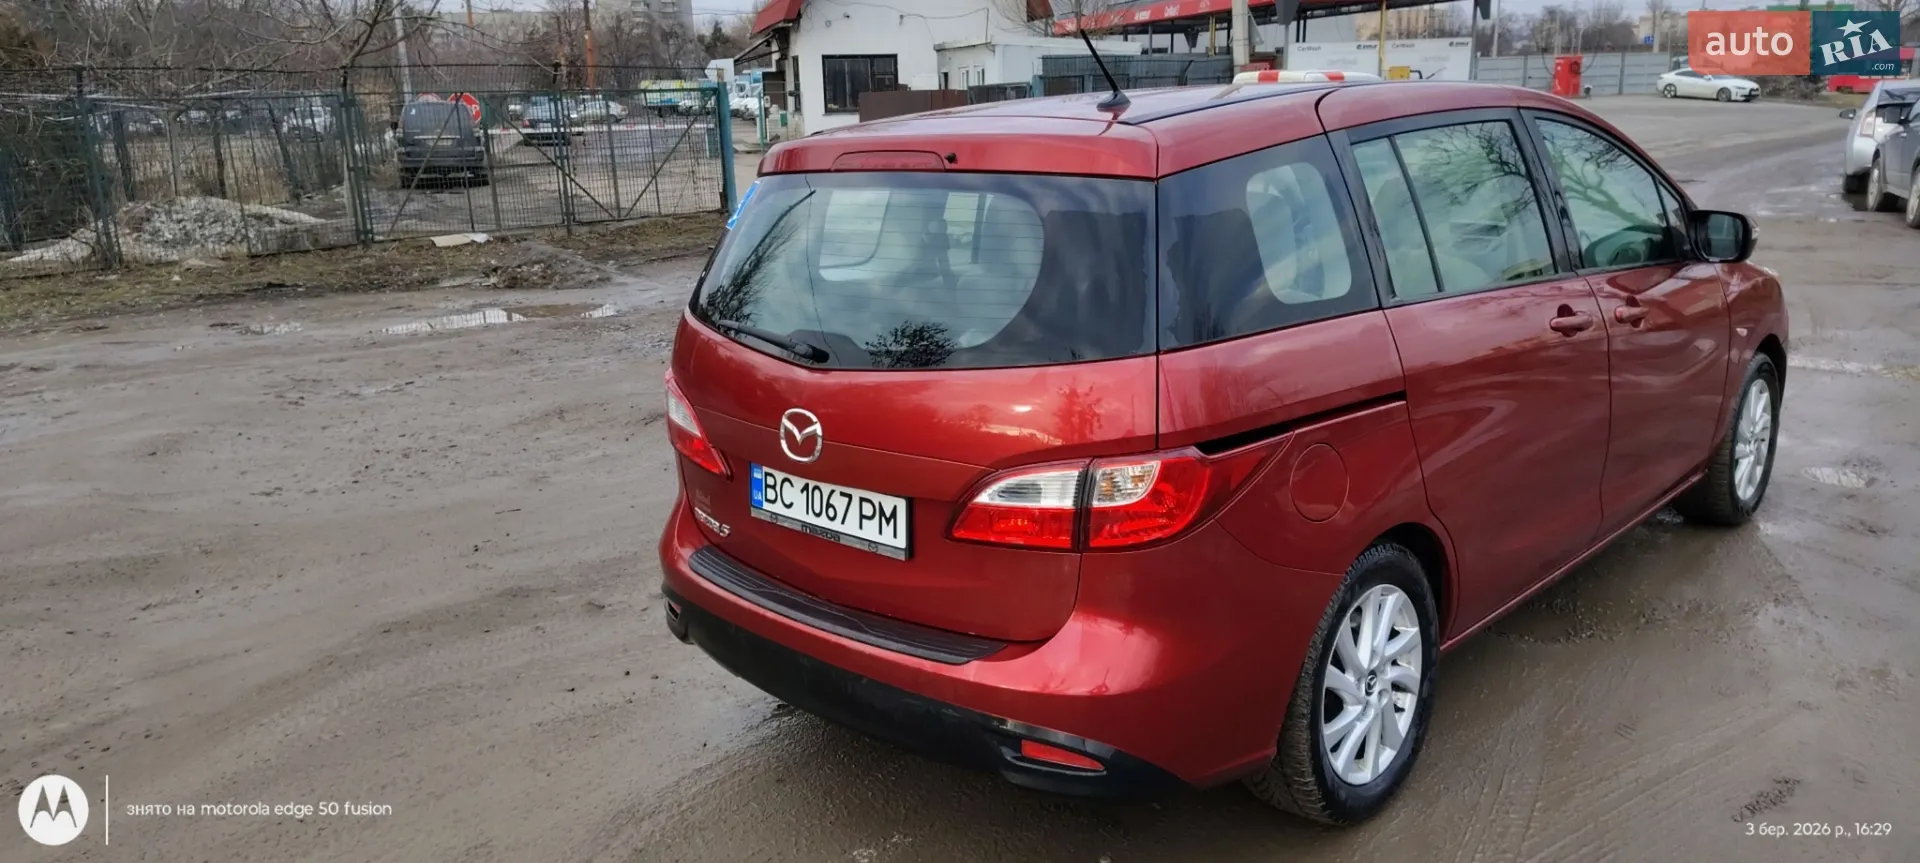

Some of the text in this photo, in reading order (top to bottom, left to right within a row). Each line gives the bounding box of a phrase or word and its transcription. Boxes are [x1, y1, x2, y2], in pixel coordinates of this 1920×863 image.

[753, 489, 762, 500] UA
[764, 471, 898, 539] BC 1067 PM
